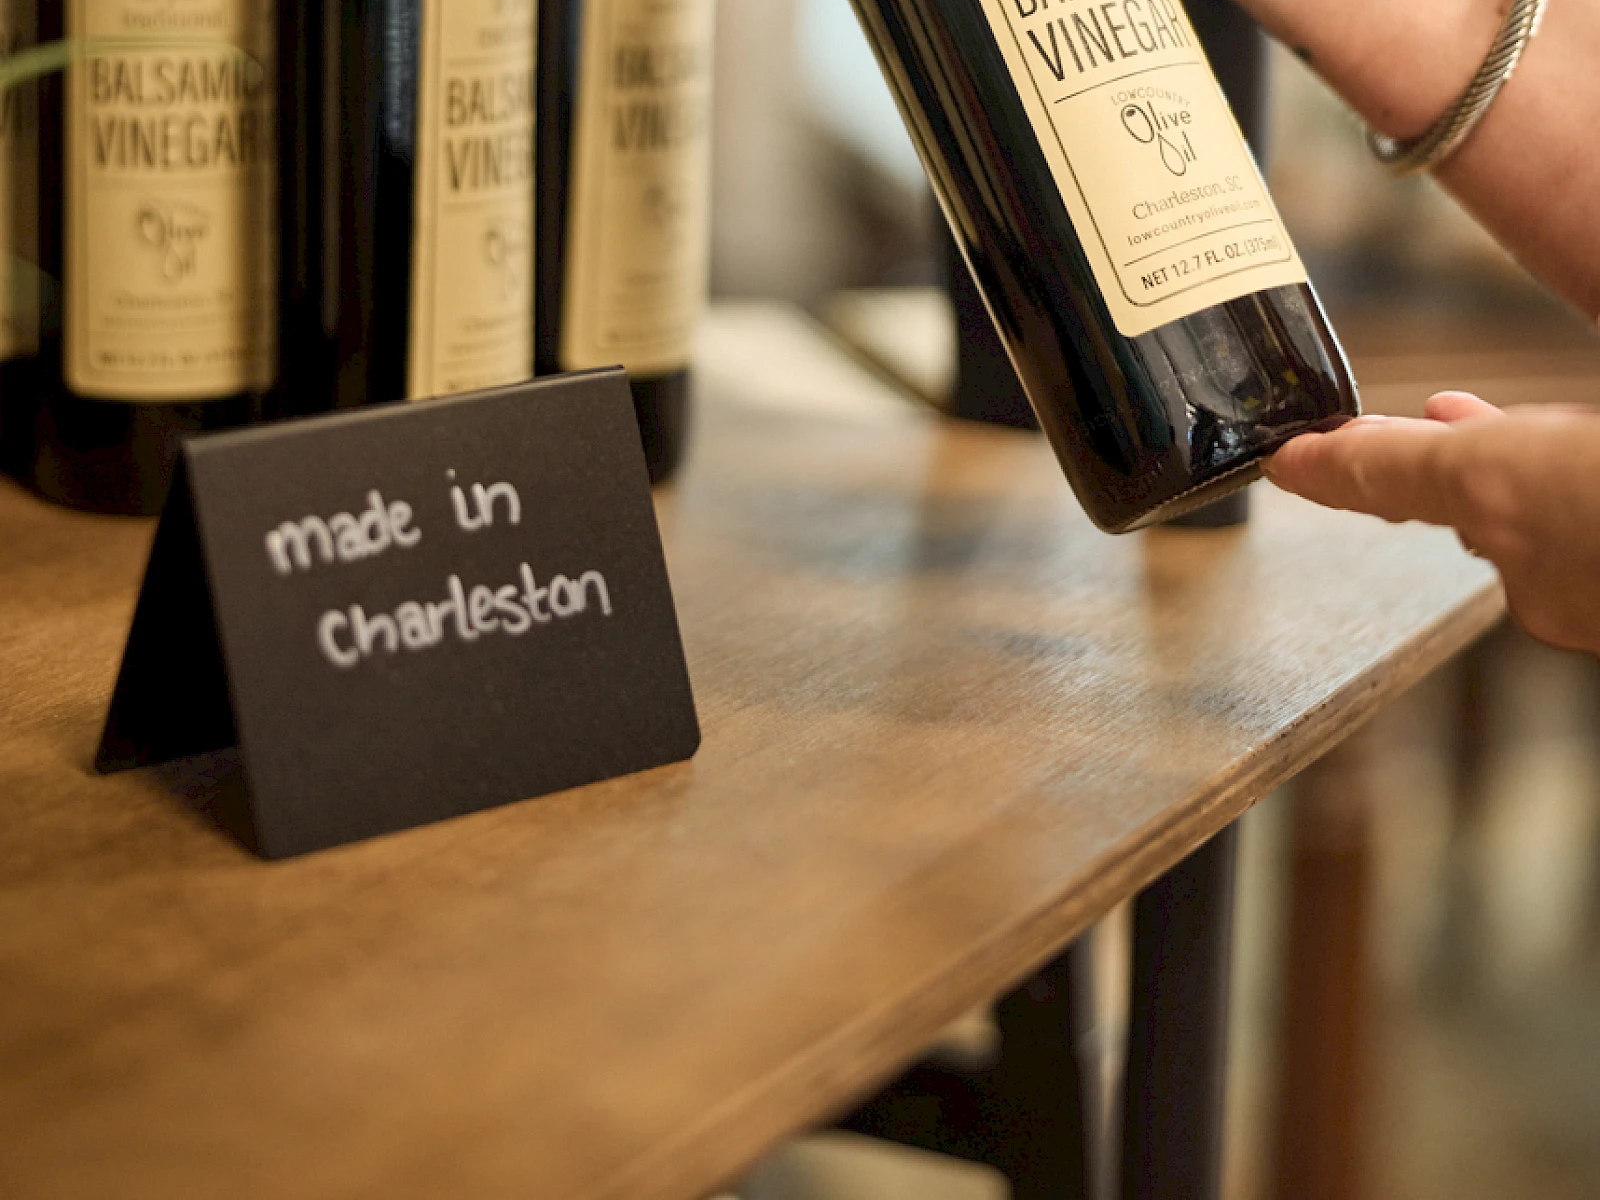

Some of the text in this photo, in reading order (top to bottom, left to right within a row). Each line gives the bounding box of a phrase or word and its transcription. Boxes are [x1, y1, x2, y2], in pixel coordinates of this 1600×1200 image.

[1110, 85, 1191, 108] LOWCOUNTRY
[1120, 99, 1192, 144] Olive
[1225, 174, 1244, 192] SC
[1140, 265, 1171, 290] NET
[1171, 254, 1202, 279] 12.7
[265, 467, 521, 574] made in
